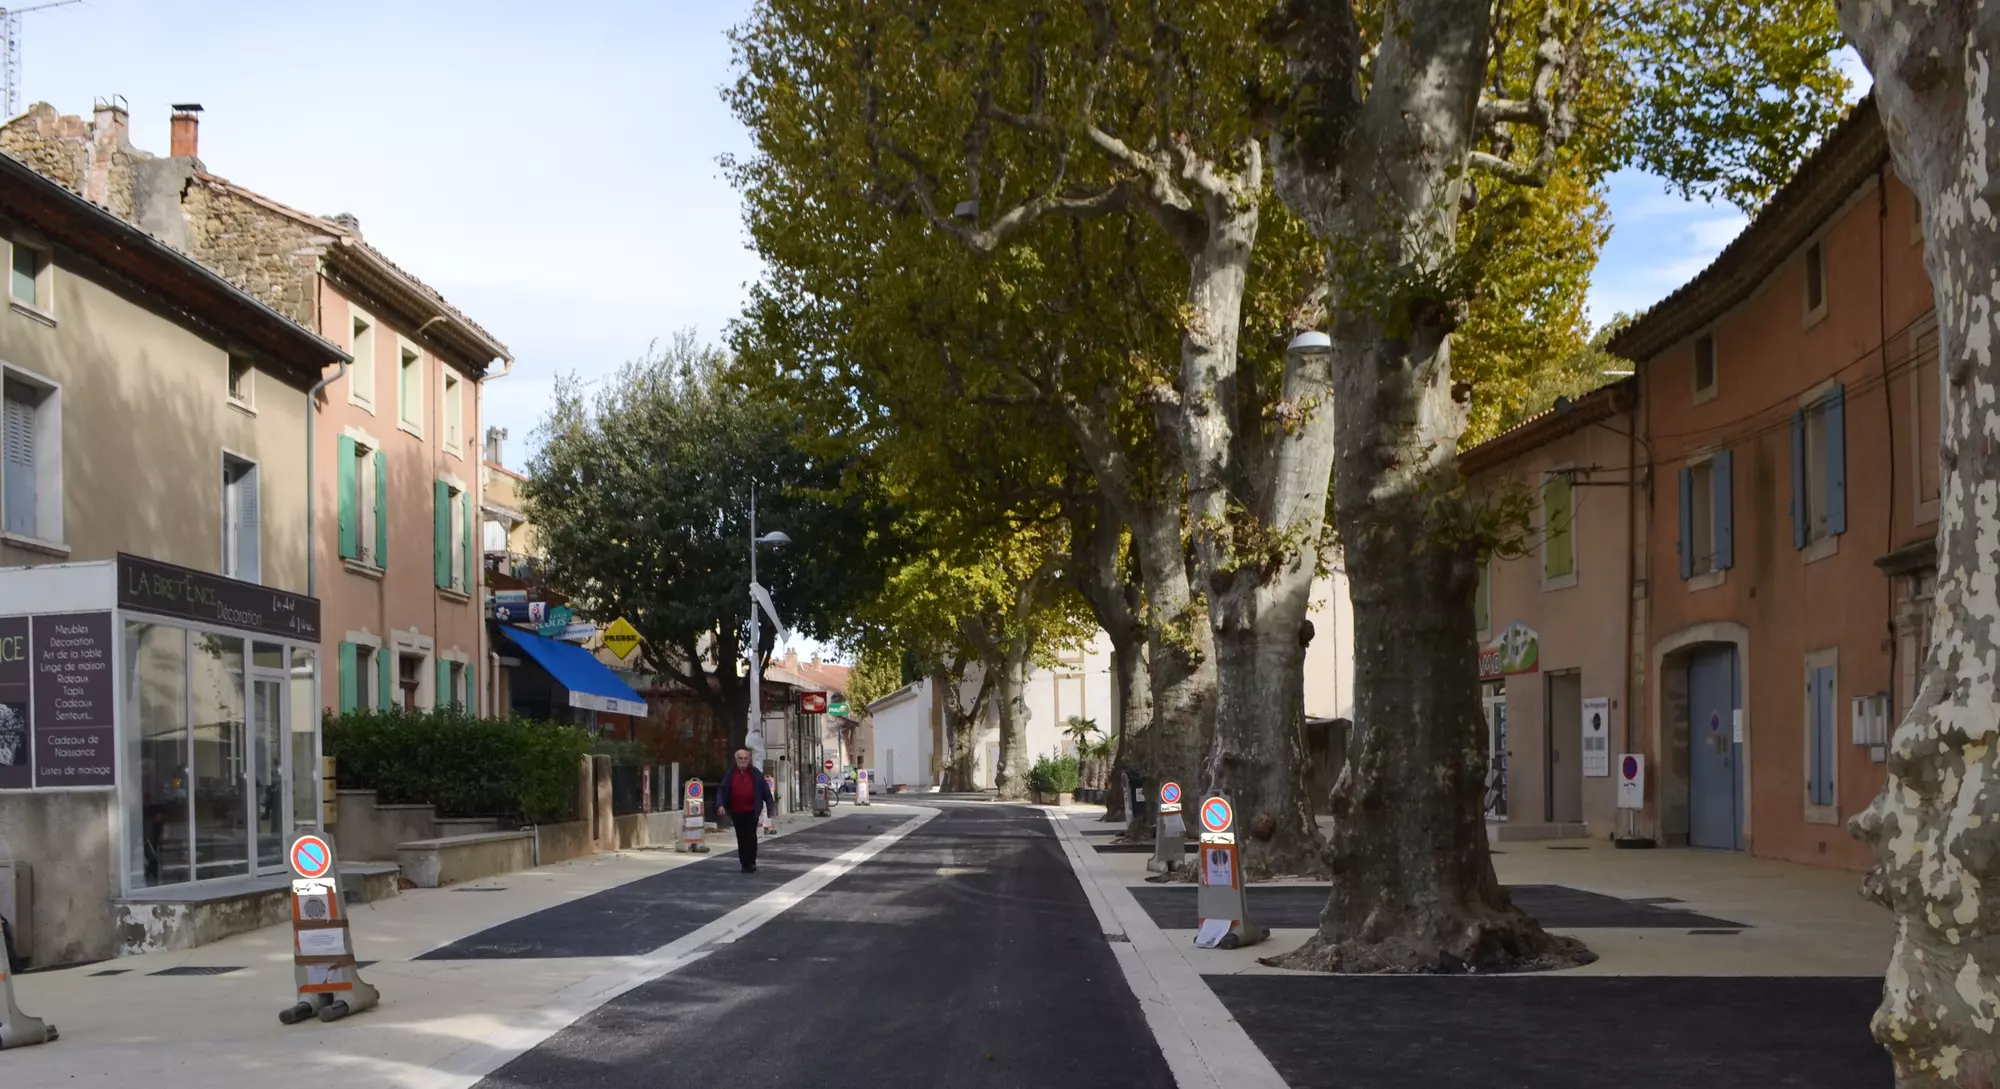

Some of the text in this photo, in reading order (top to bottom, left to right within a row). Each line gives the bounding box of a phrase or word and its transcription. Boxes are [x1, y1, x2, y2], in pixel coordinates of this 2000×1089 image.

[129, 566, 151, 597] LA
[217, 600, 262, 627] Décoration
[55, 624, 89, 635] Meubles
[50, 637, 95, 647] Décoration
[604, 634, 637, 642] PRESSE
[43, 647, 103, 660] Art de la table
[40, 661, 105, 673] Linge de maison
[57, 673, 89, 684] Rideaux
[63, 685, 84, 697] Tapis
[54, 698, 93, 709] Cadeaux
[47, 734, 99, 746] Cadeaux de
[54, 747, 96, 757] Naissance
[40, 764, 111, 776] Listes de mariage
